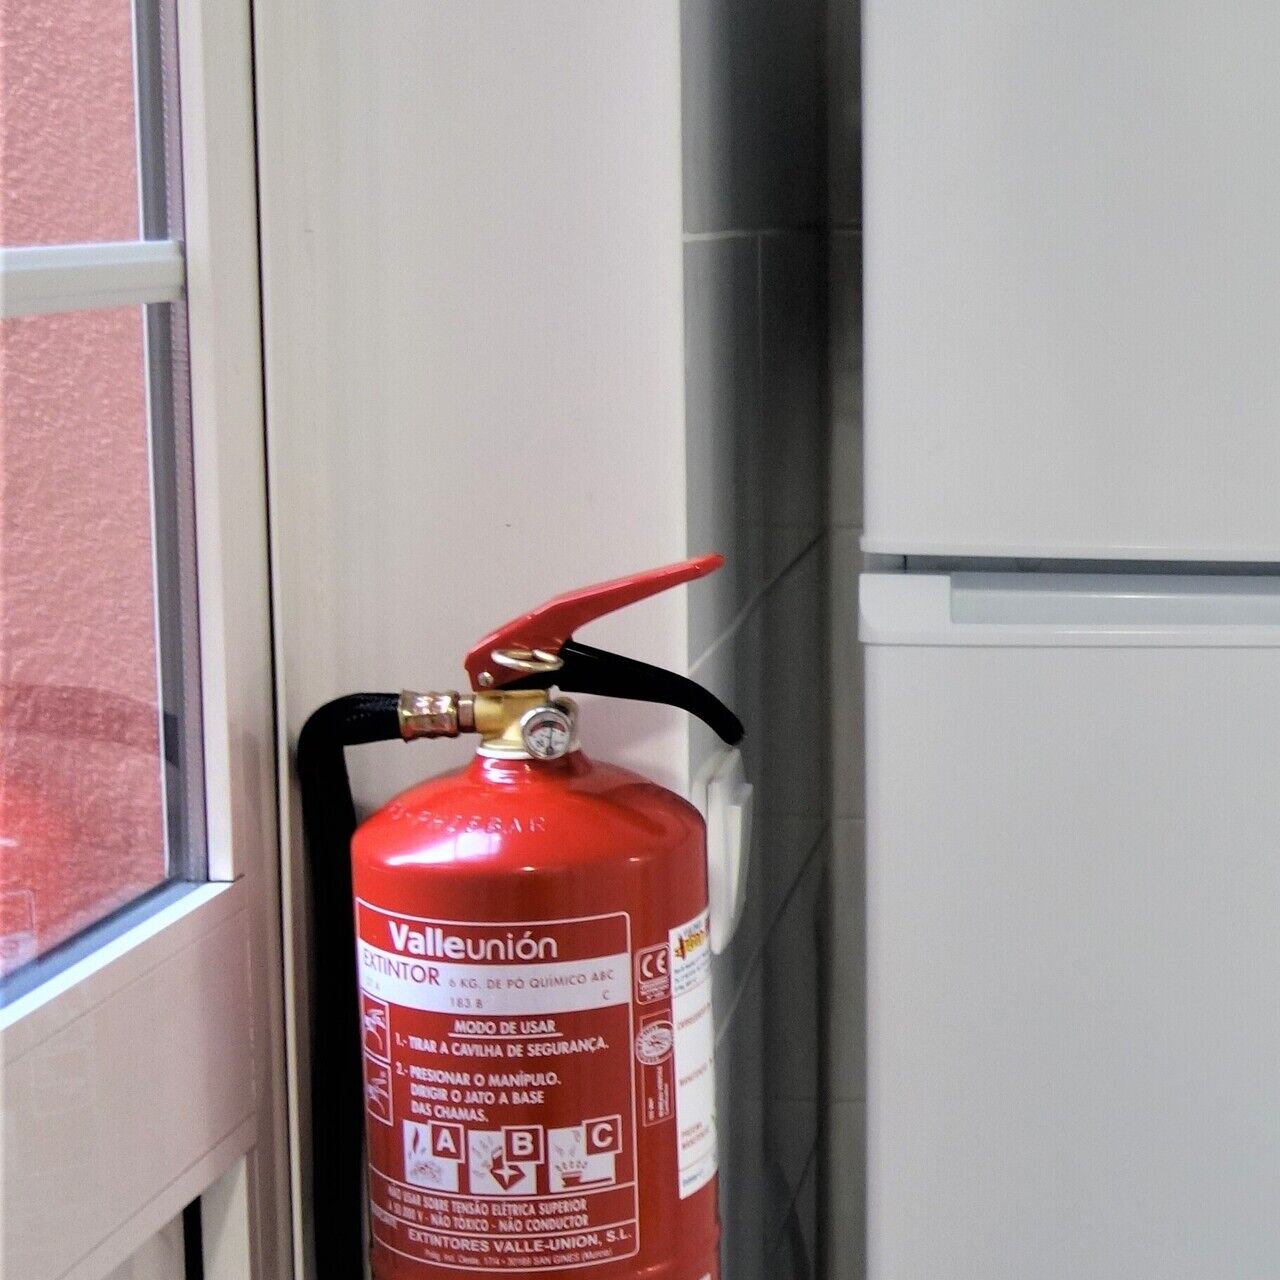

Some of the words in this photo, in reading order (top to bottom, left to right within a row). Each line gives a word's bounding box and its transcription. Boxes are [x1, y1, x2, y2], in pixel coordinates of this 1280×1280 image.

[388, 920, 558, 961] Valleunión
[364, 948, 441, 987] EXTINTOR
[486, 979, 502, 990] DE
[591, 969, 615, 982] ABC
[641, 949, 668, 979] CE
[453, 1019, 497, 1035] MODO
[500, 1021, 518, 1035] DE
[520, 1019, 556, 1034] USAR
[439, 1040, 450, 1055] A
[451, 1042, 504, 1058] CAVILHA
[506, 1043, 524, 1058] DE
[526, 1035, 610, 1058] SEGURANÇA.
[473, 1073, 486, 1087] O
[410, 1100, 433, 1117] DAS
[450, 1089, 462, 1104] O
[464, 1090, 496, 1106] JATO
[498, 1091, 509, 1105] A
[511, 1090, 545, 1105] BASE
[436, 1128, 457, 1153] A
[511, 1132, 534, 1156] B
[591, 1123, 614, 1148] C
[538, 1198, 588, 1215] SUPERIOR
[498, 1215, 523, 1232] NÃO
[525, 1213, 589, 1232] CONDUCTOR
[408, 1226, 490, 1253] EXTINTORES
